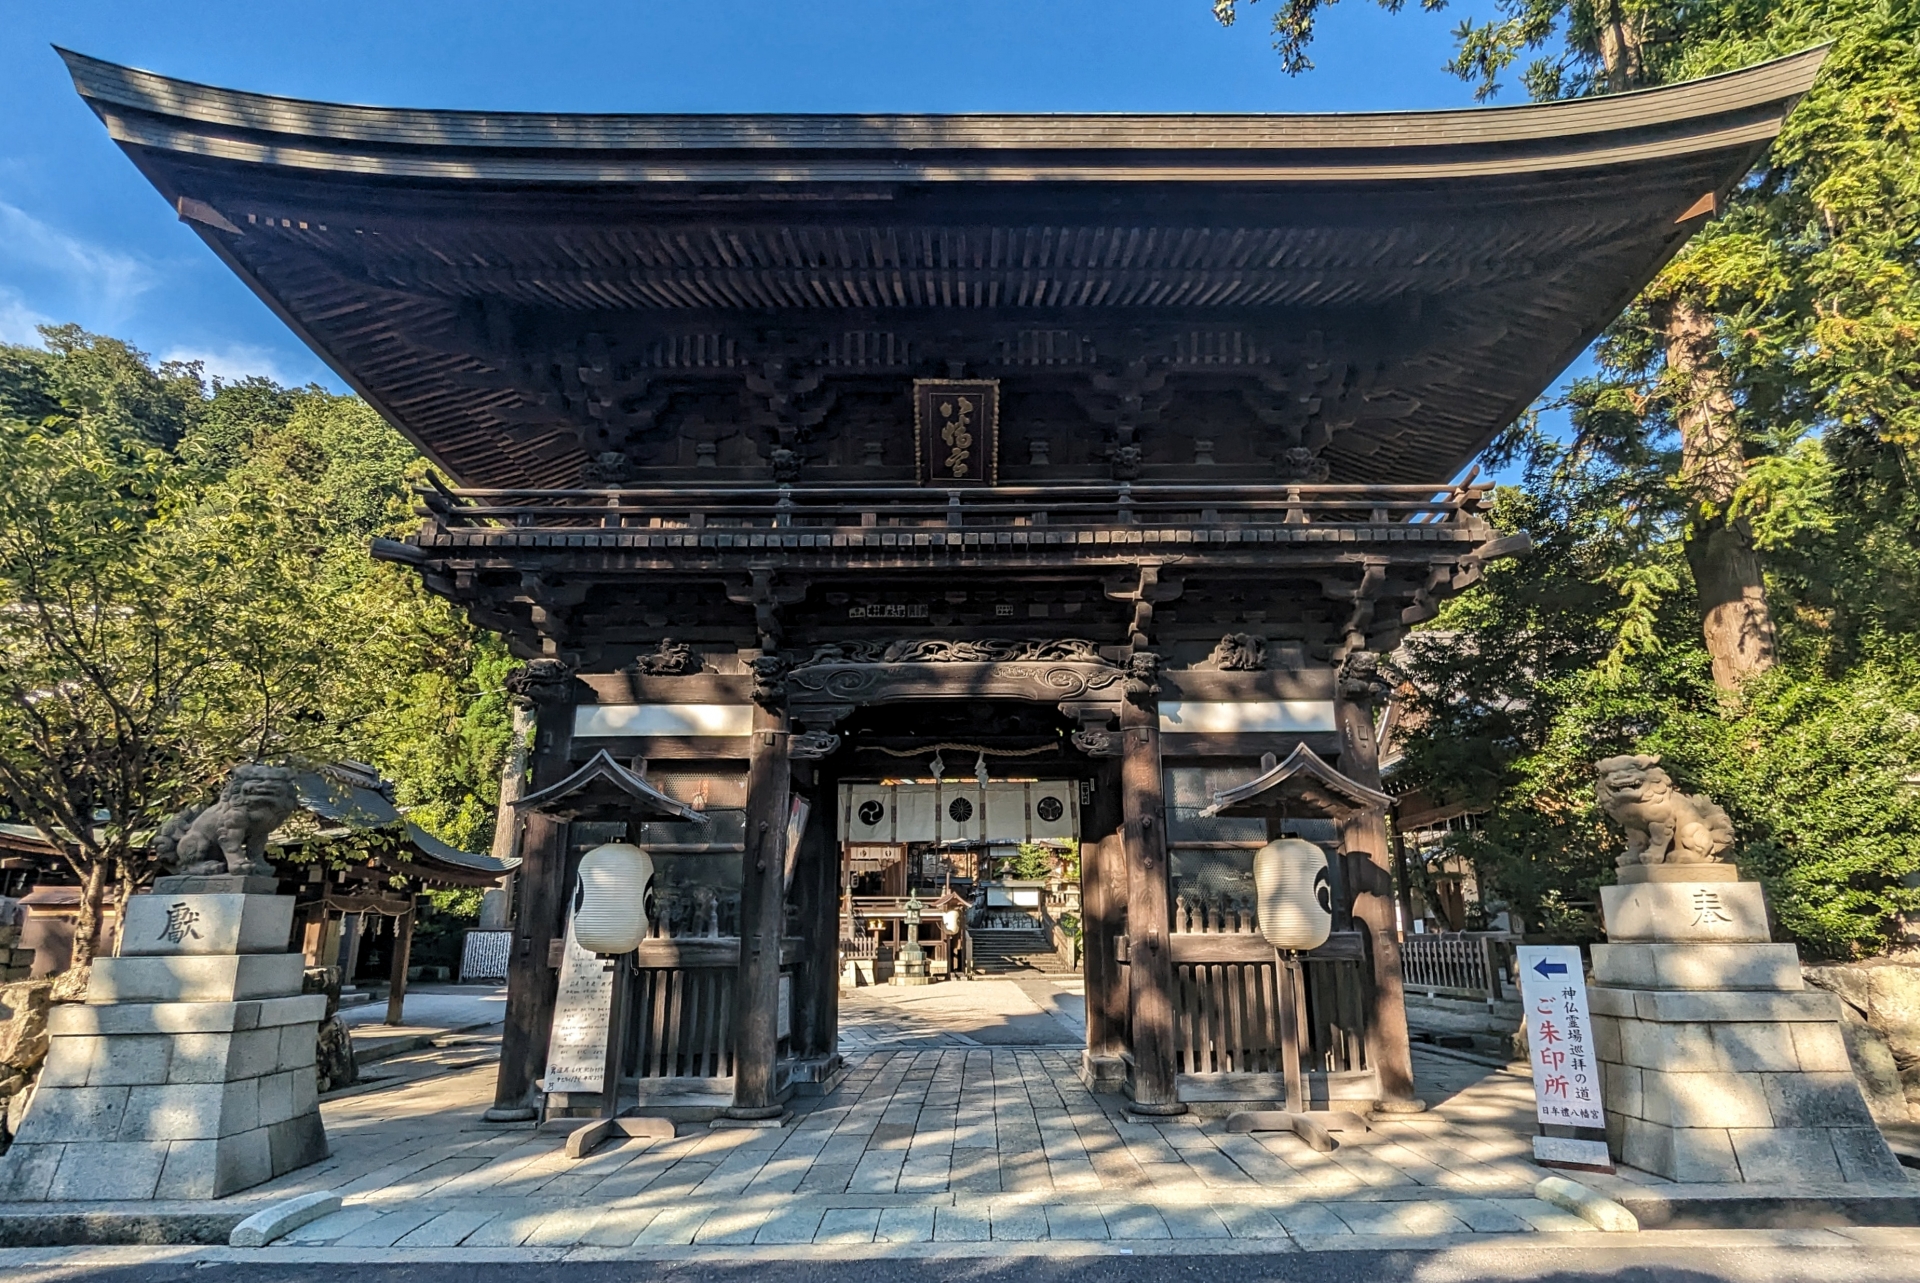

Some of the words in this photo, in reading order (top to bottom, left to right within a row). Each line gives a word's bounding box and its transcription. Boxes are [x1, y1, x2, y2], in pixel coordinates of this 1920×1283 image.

[1690, 889, 1732, 930] 奉
[1537, 996, 1569, 1099] ご朱印所
[1561, 986, 1591, 1101] 神仏霊場巡拝の道
